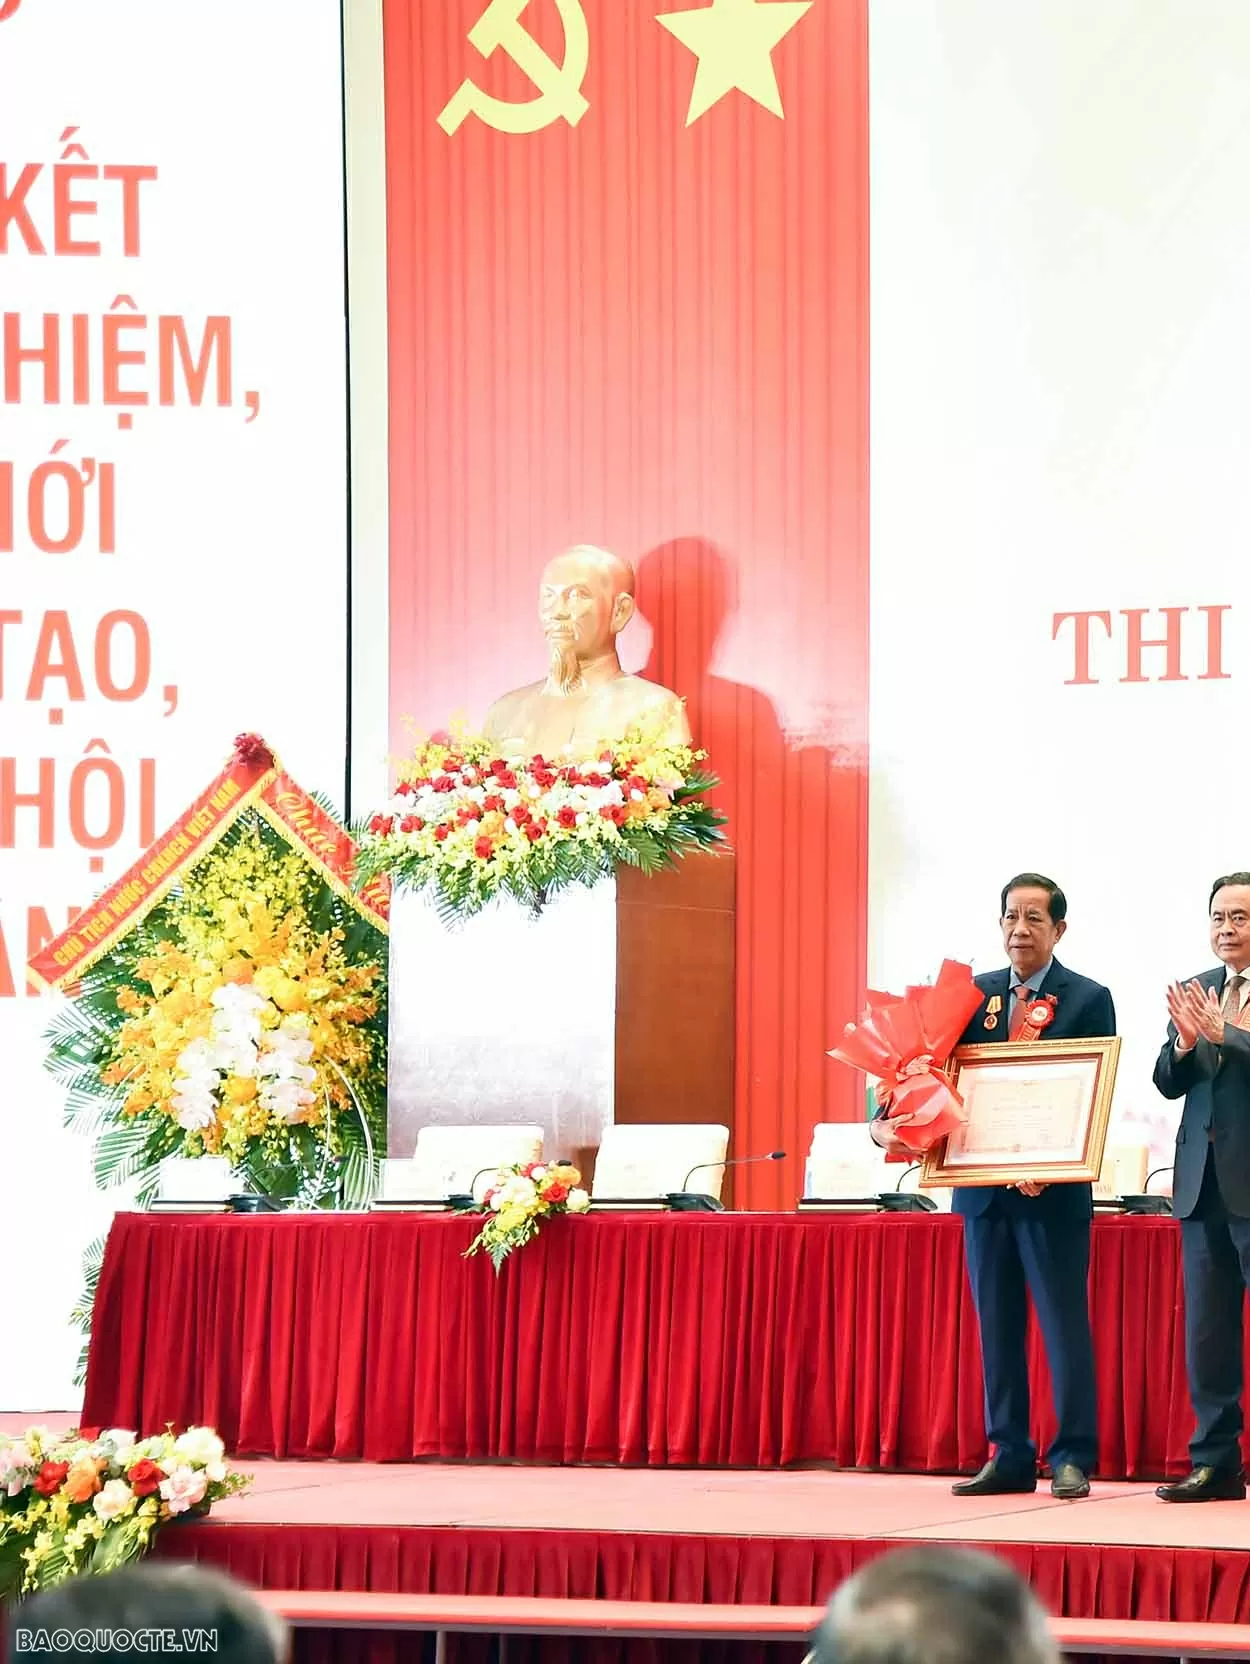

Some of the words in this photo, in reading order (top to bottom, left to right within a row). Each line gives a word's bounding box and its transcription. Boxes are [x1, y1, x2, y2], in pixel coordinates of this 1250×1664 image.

[0, 125, 158, 258] KẾT
[3, 294, 260, 430] HIỆM,
[0, 438, 116, 554] ỚI
[1052, 604, 1233, 685] THI
[0, 737, 156, 873] HỘI
